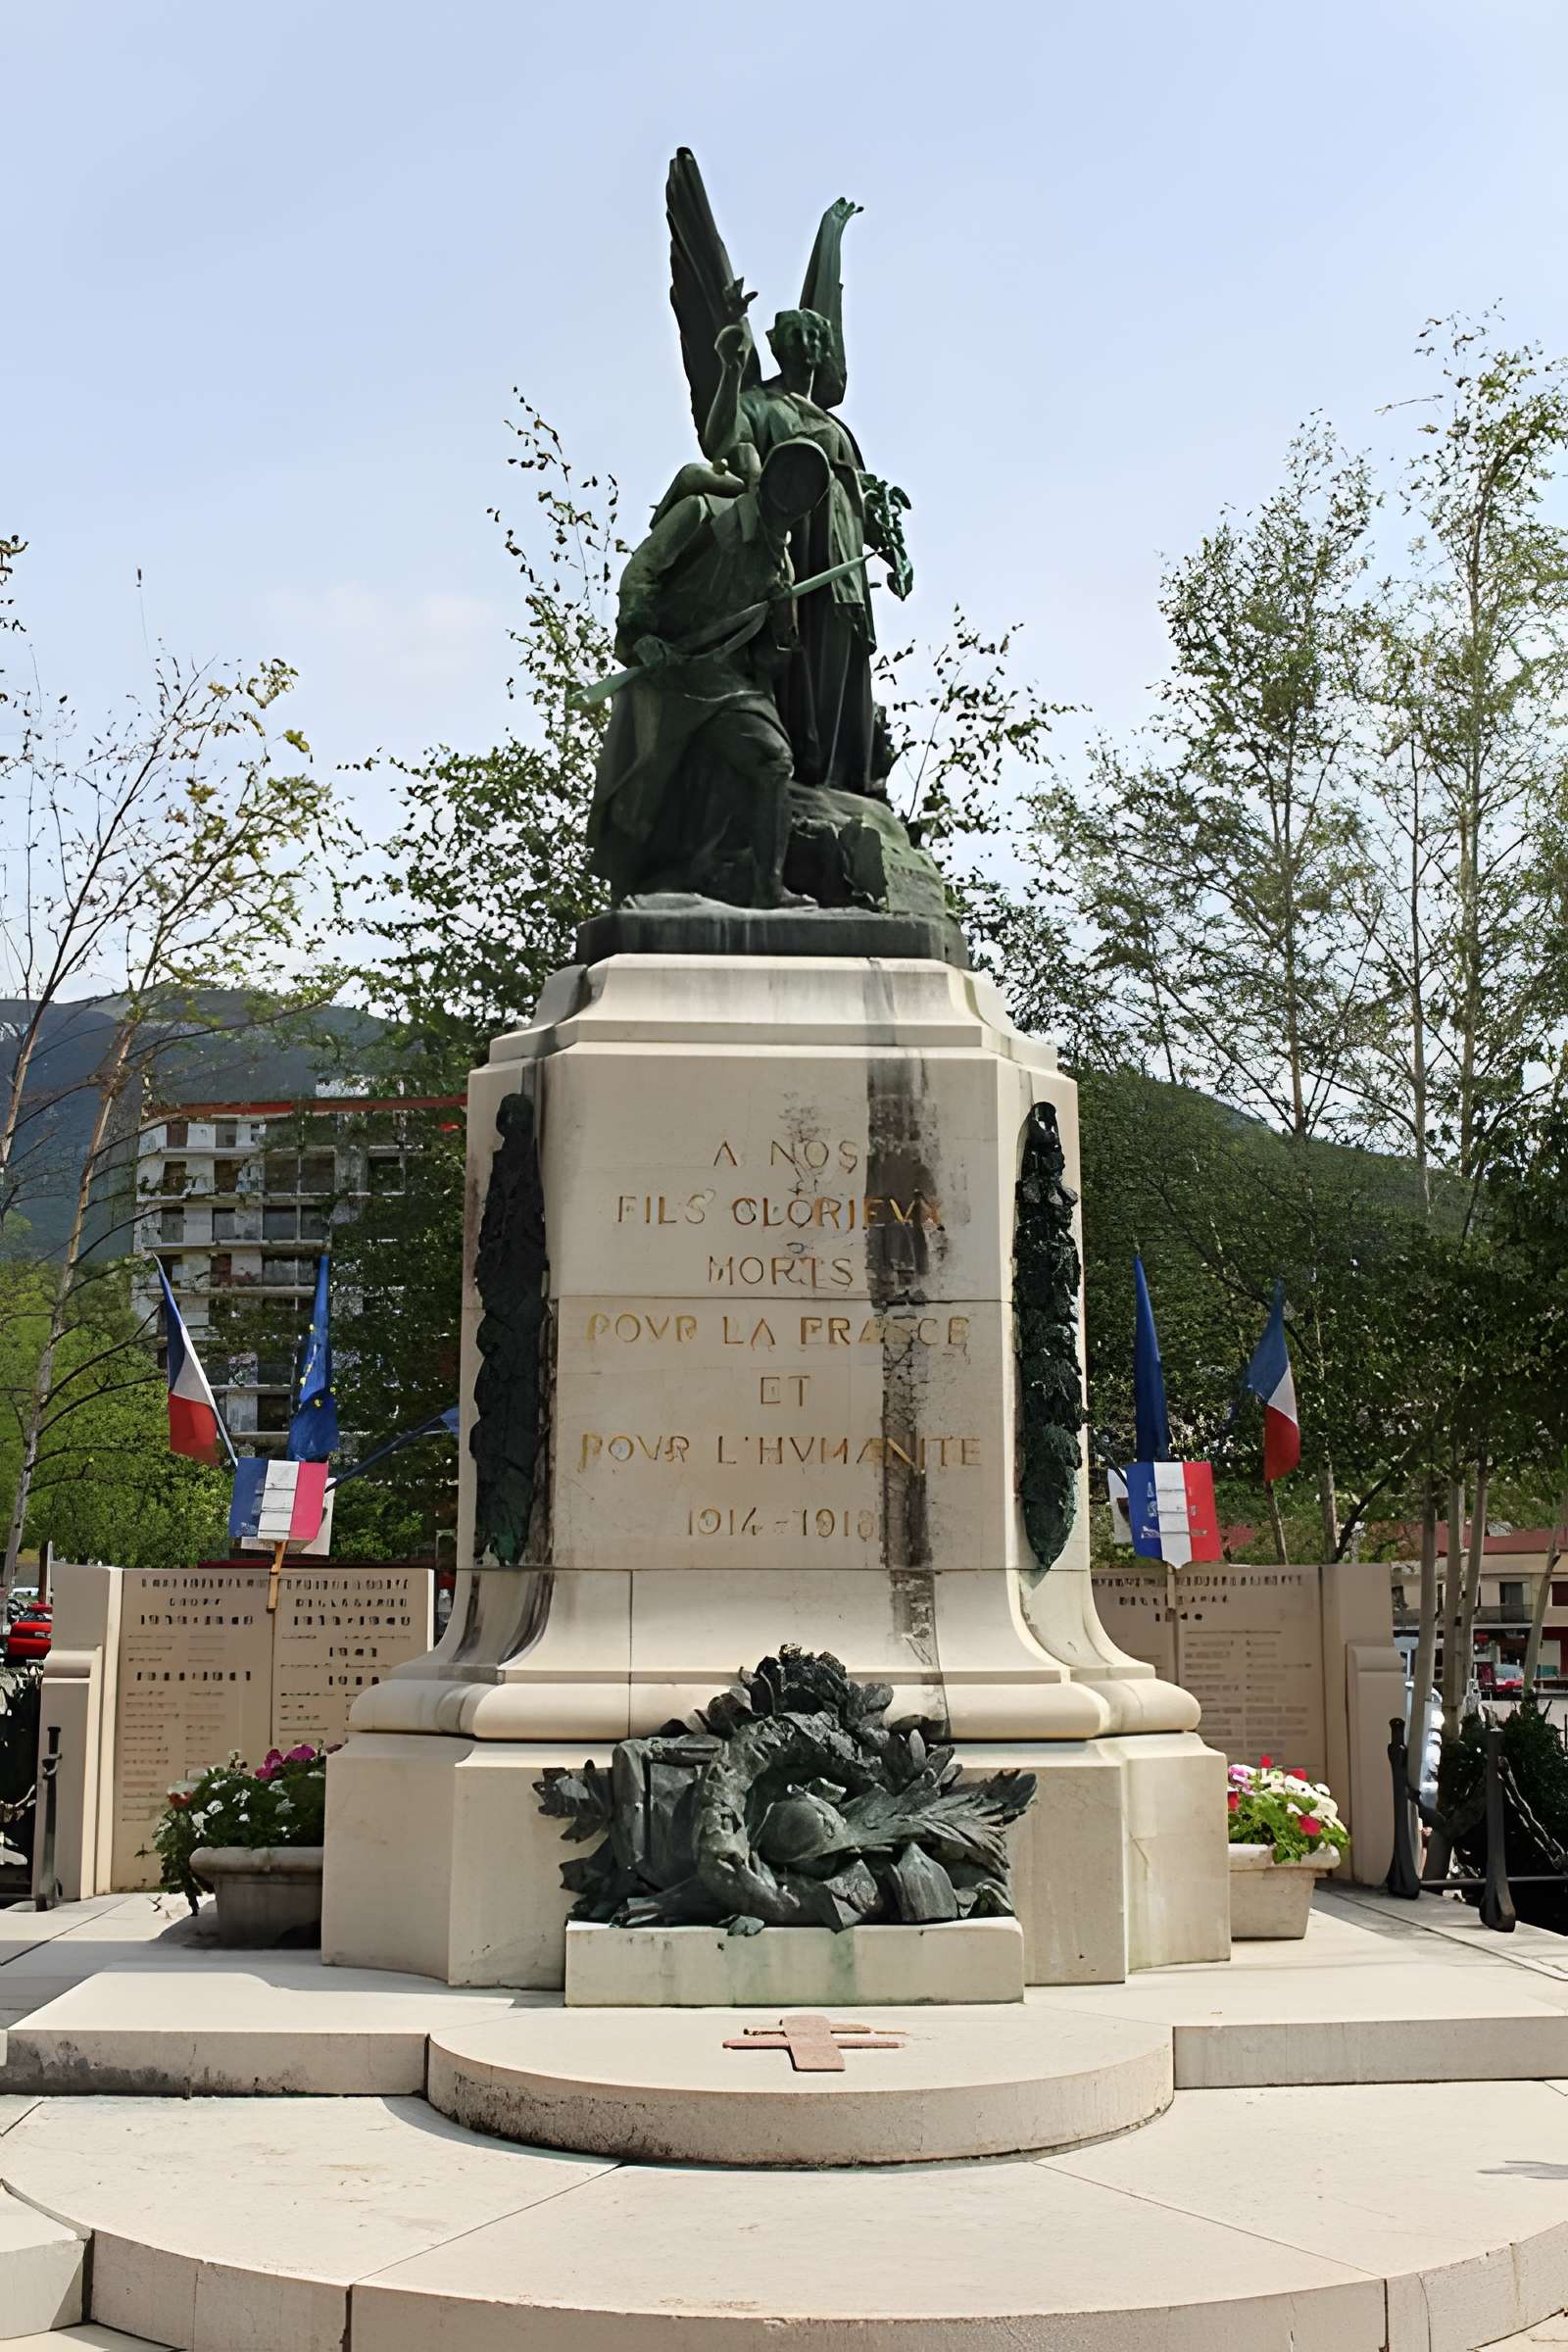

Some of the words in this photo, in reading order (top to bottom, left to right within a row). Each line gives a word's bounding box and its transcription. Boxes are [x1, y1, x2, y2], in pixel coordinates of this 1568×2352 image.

[713, 1140, 738, 1167] A
[770, 1140, 858, 1174] NOS
[617, 1194, 708, 1225] FILS
[709, 1254, 854, 1286] MORTS
[588, 1313, 698, 1343] POVR
[722, 1315, 777, 1346] LA
[800, 1316, 970, 1346] FRACE
[760, 1375, 811, 1406] ET
[579, 1434, 690, 1467] POVR
